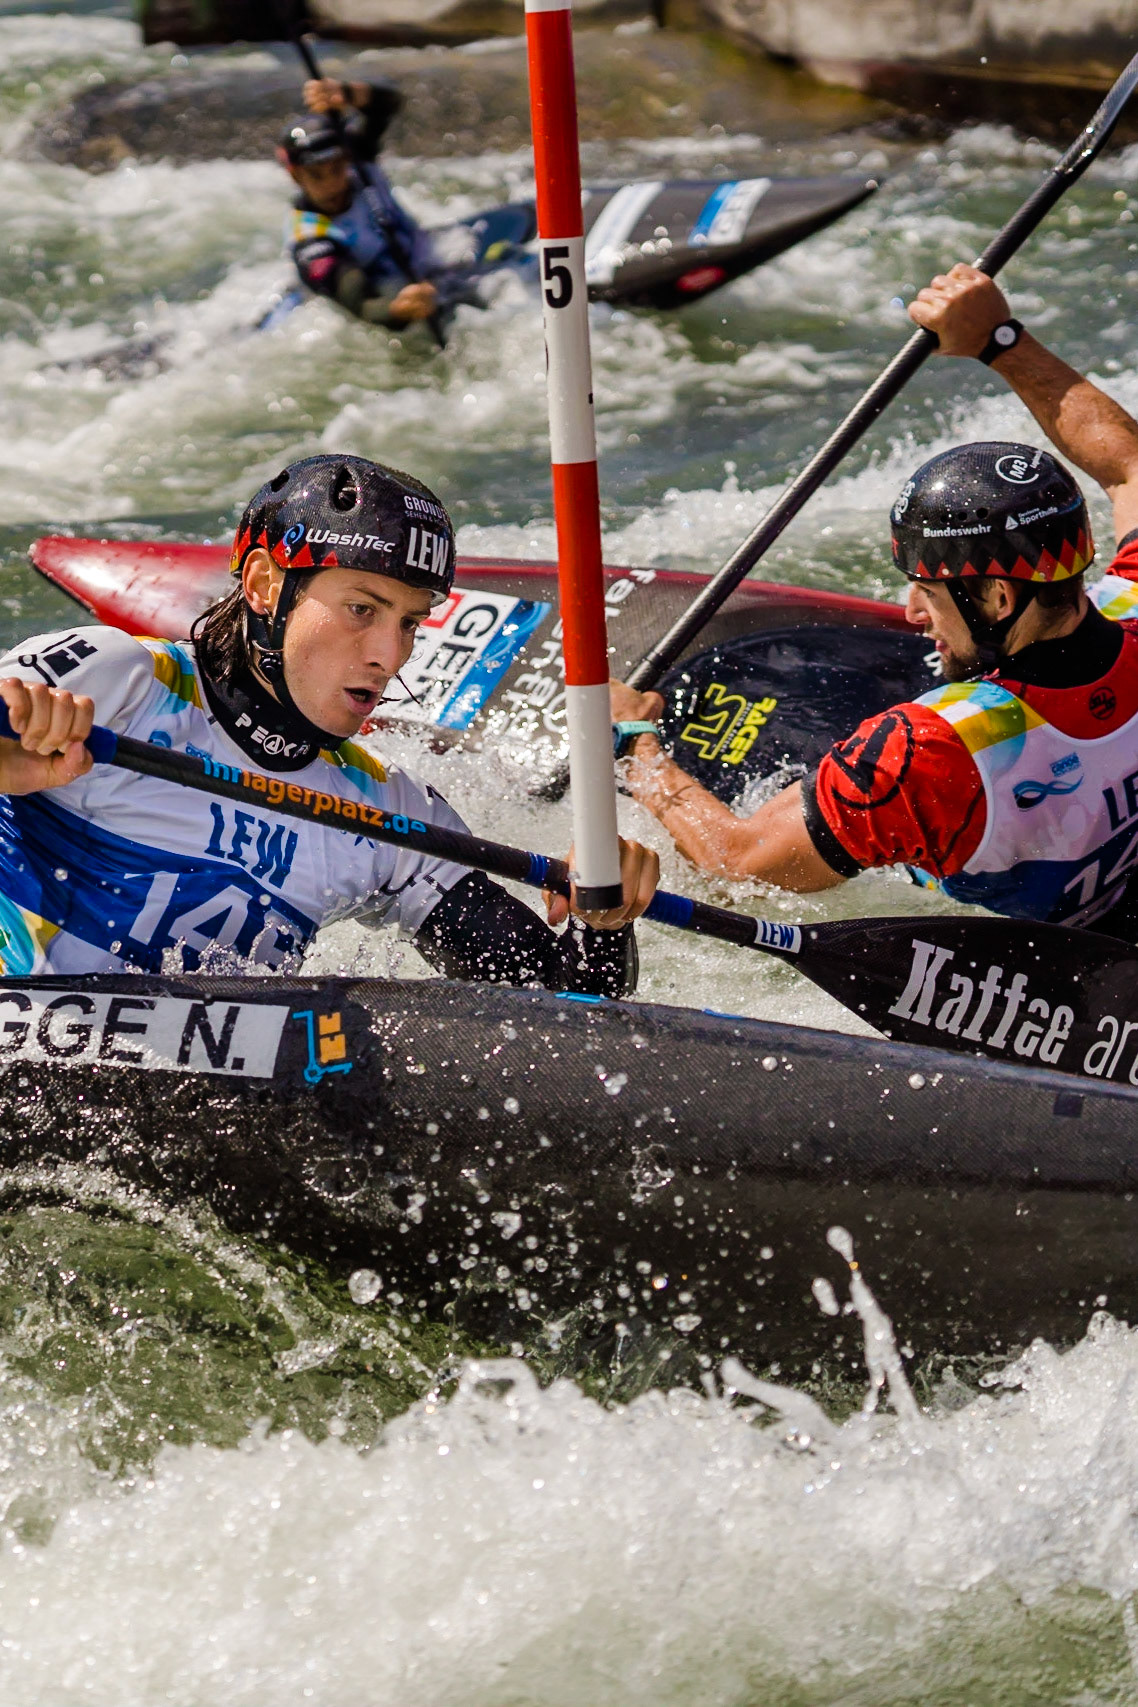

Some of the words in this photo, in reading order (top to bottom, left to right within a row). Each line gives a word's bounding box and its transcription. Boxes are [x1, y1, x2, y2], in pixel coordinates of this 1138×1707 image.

[543, 246, 573, 309] 5
[305, 527, 396, 553] WashTec
[406, 527, 449, 577] LEW
[923, 524, 992, 538] Bundeswehr
[204, 801, 298, 889] LEW
[760, 921, 796, 950] LEW
[888, 938, 1075, 1065] Kaffee
[177, 1003, 245, 1071] N.
